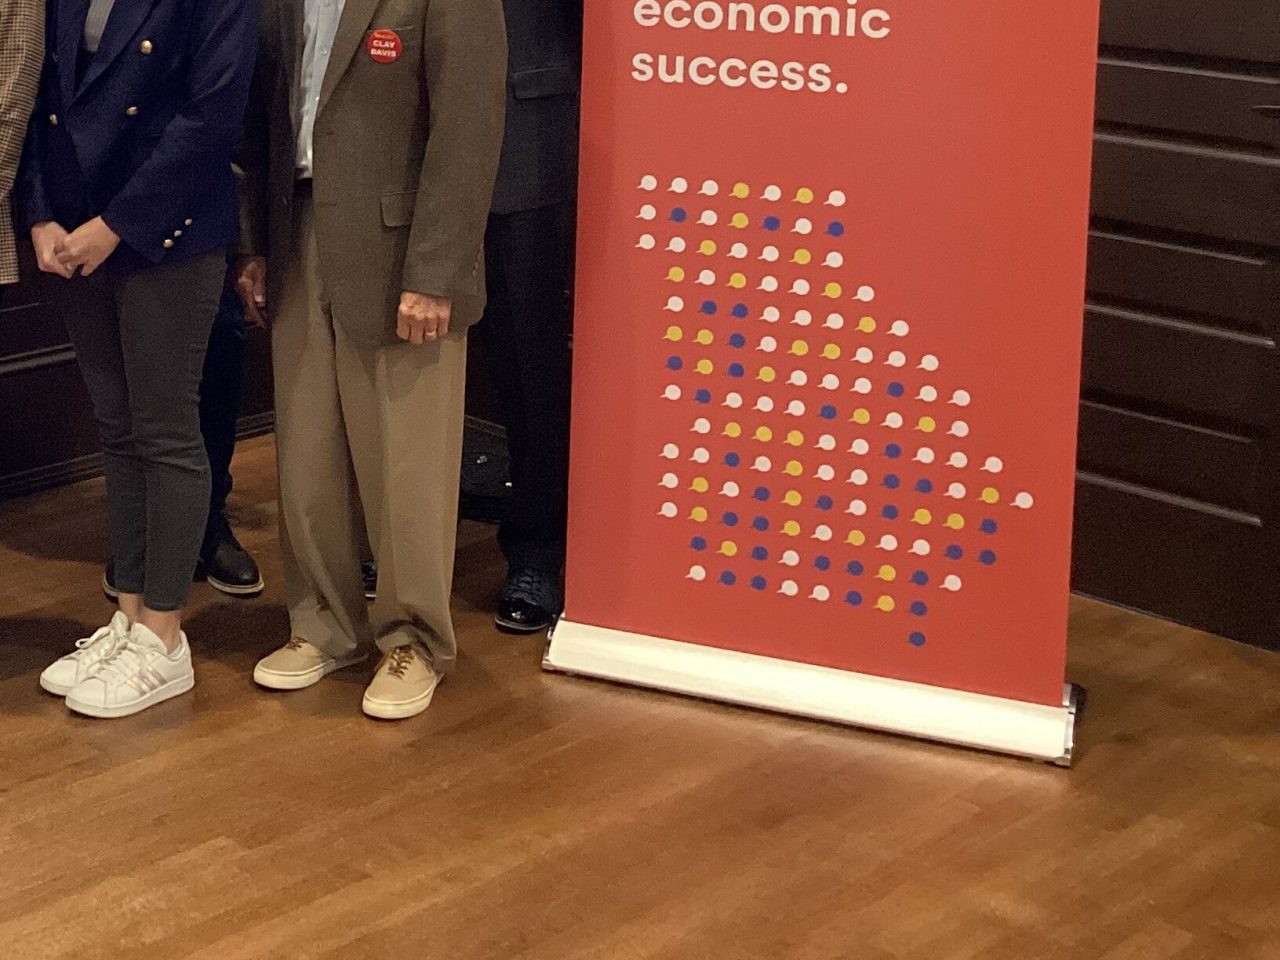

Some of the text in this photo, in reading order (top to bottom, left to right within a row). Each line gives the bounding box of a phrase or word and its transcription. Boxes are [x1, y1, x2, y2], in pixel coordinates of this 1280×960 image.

[373, 40, 396, 48] CLAY
[371, 48, 397, 57] DAVIS
[631, 53, 848, 93] success.
